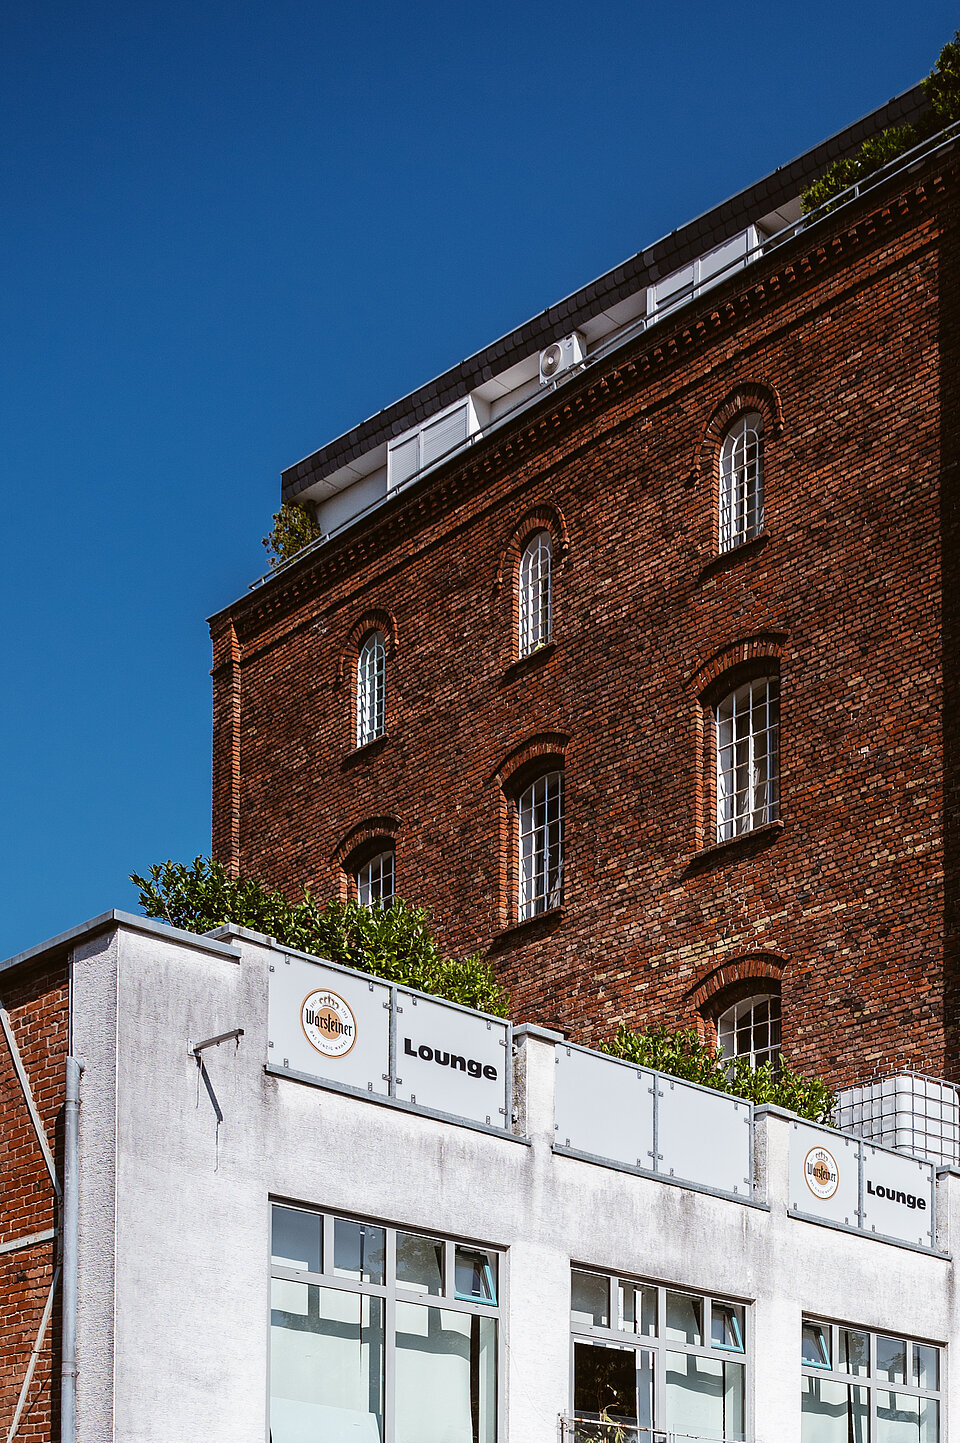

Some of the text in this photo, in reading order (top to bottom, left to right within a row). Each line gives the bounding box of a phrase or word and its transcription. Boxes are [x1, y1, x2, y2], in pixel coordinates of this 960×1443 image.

[305, 1007, 353, 1037] Warsteiner
[403, 1037, 498, 1081] Lounge
[807, 1161, 837, 1183] Warsteiner
[866, 1180, 927, 1210] Lounge
